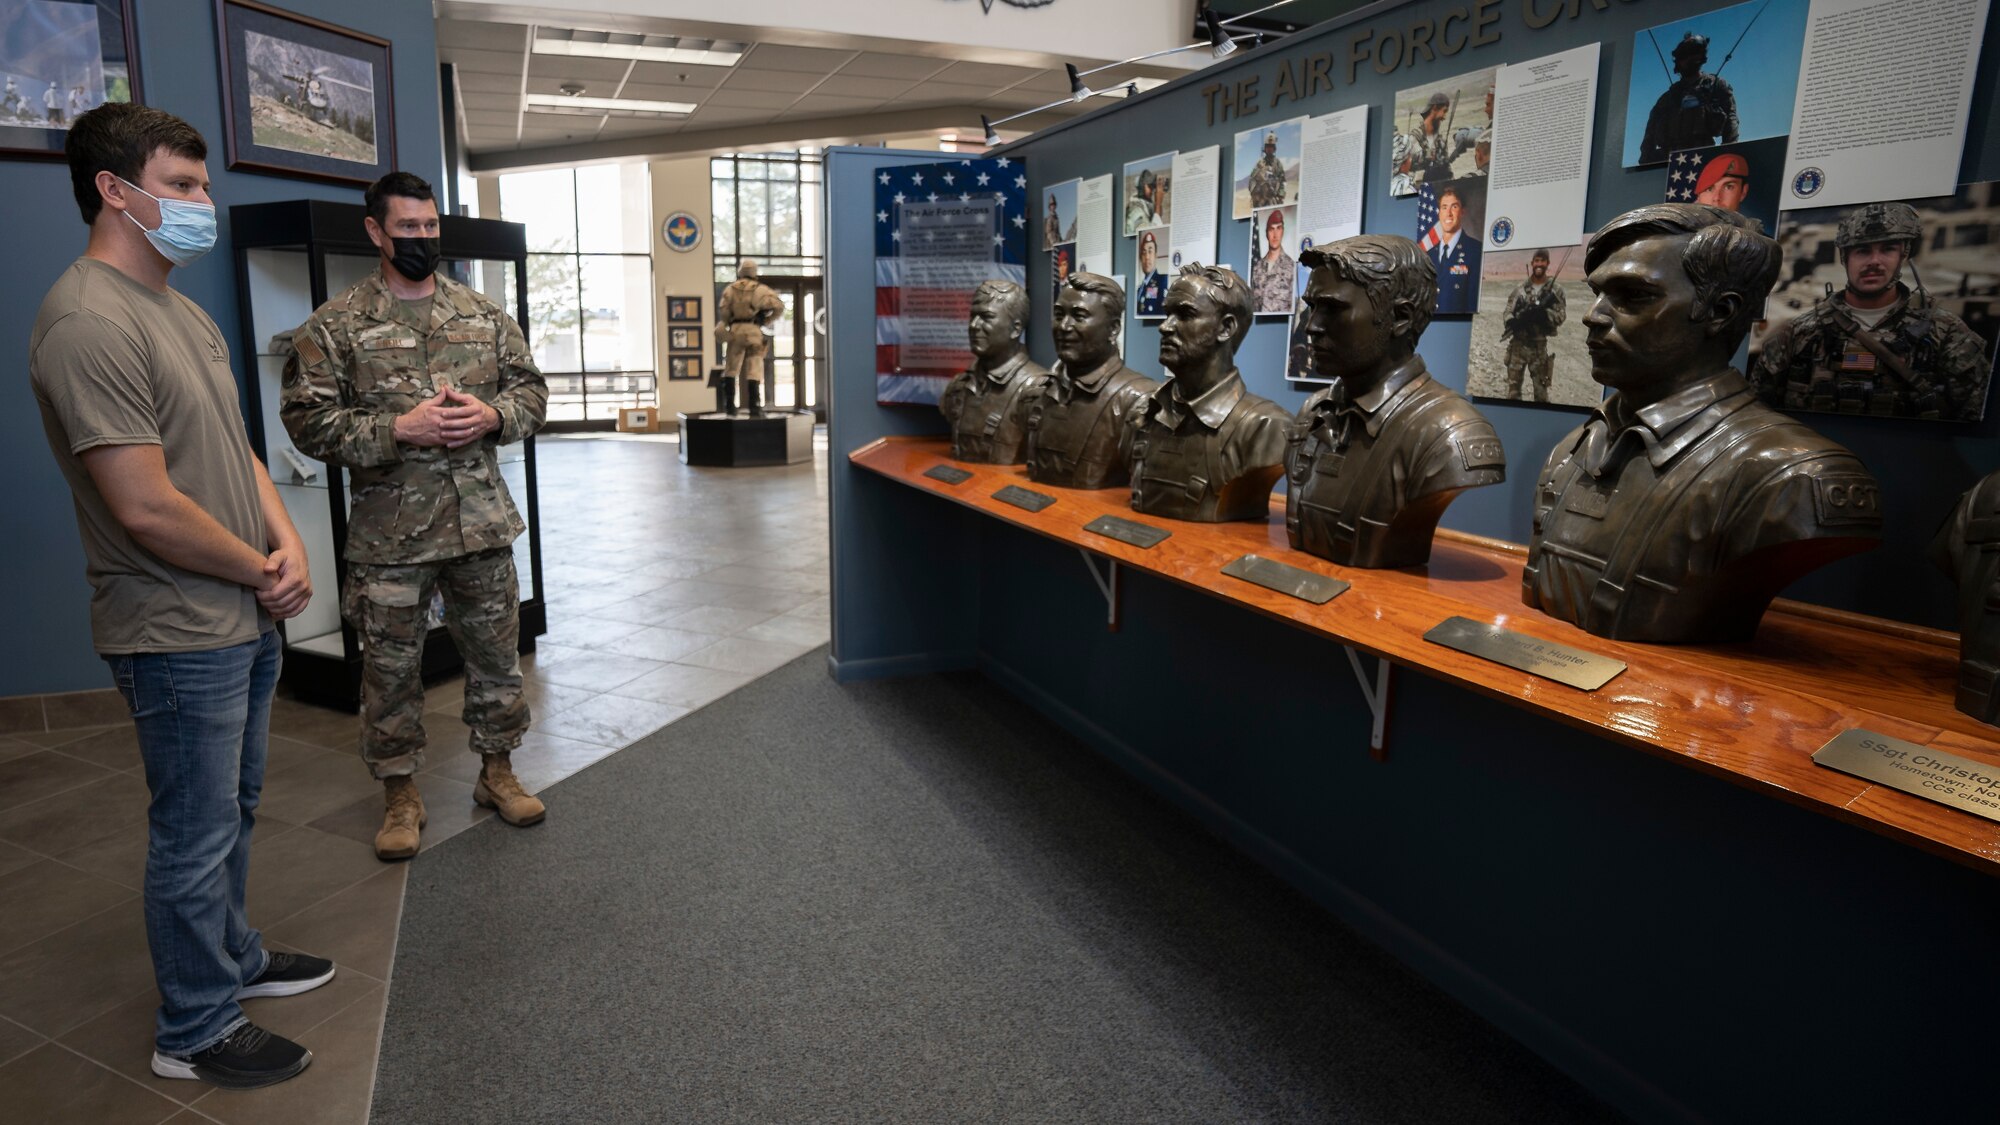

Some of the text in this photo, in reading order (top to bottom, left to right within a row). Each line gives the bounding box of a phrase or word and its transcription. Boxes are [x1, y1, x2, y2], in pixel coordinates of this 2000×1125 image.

[1202, 75, 1260, 127] THE
[1271, 51, 1335, 108] AIR
[1345, 0, 1501, 85] FORCE
[904, 206, 990, 219] The Air Force Cross
[1827, 483, 1879, 512] CCT
[1536, 655, 1568, 668] Georgia
[1547, 649, 1590, 666] Hunter
[1859, 739, 2000, 789] SSgt Christop
[1888, 761, 1973, 790] Hometown:
[1922, 780, 1956, 795] CCS
